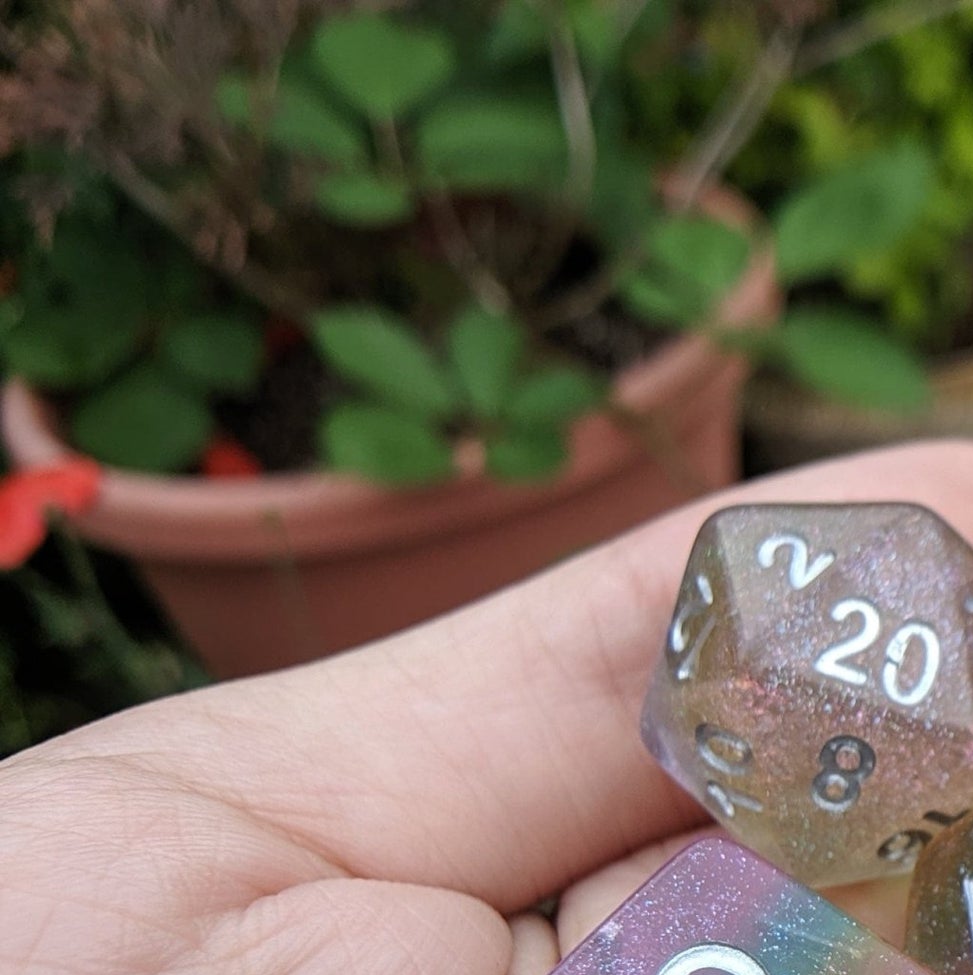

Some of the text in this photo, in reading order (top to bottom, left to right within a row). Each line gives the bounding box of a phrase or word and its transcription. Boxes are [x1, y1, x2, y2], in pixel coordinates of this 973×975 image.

[757, 533, 837, 590] 2
[813, 598, 942, 706] 20
[811, 734, 877, 814] 8
